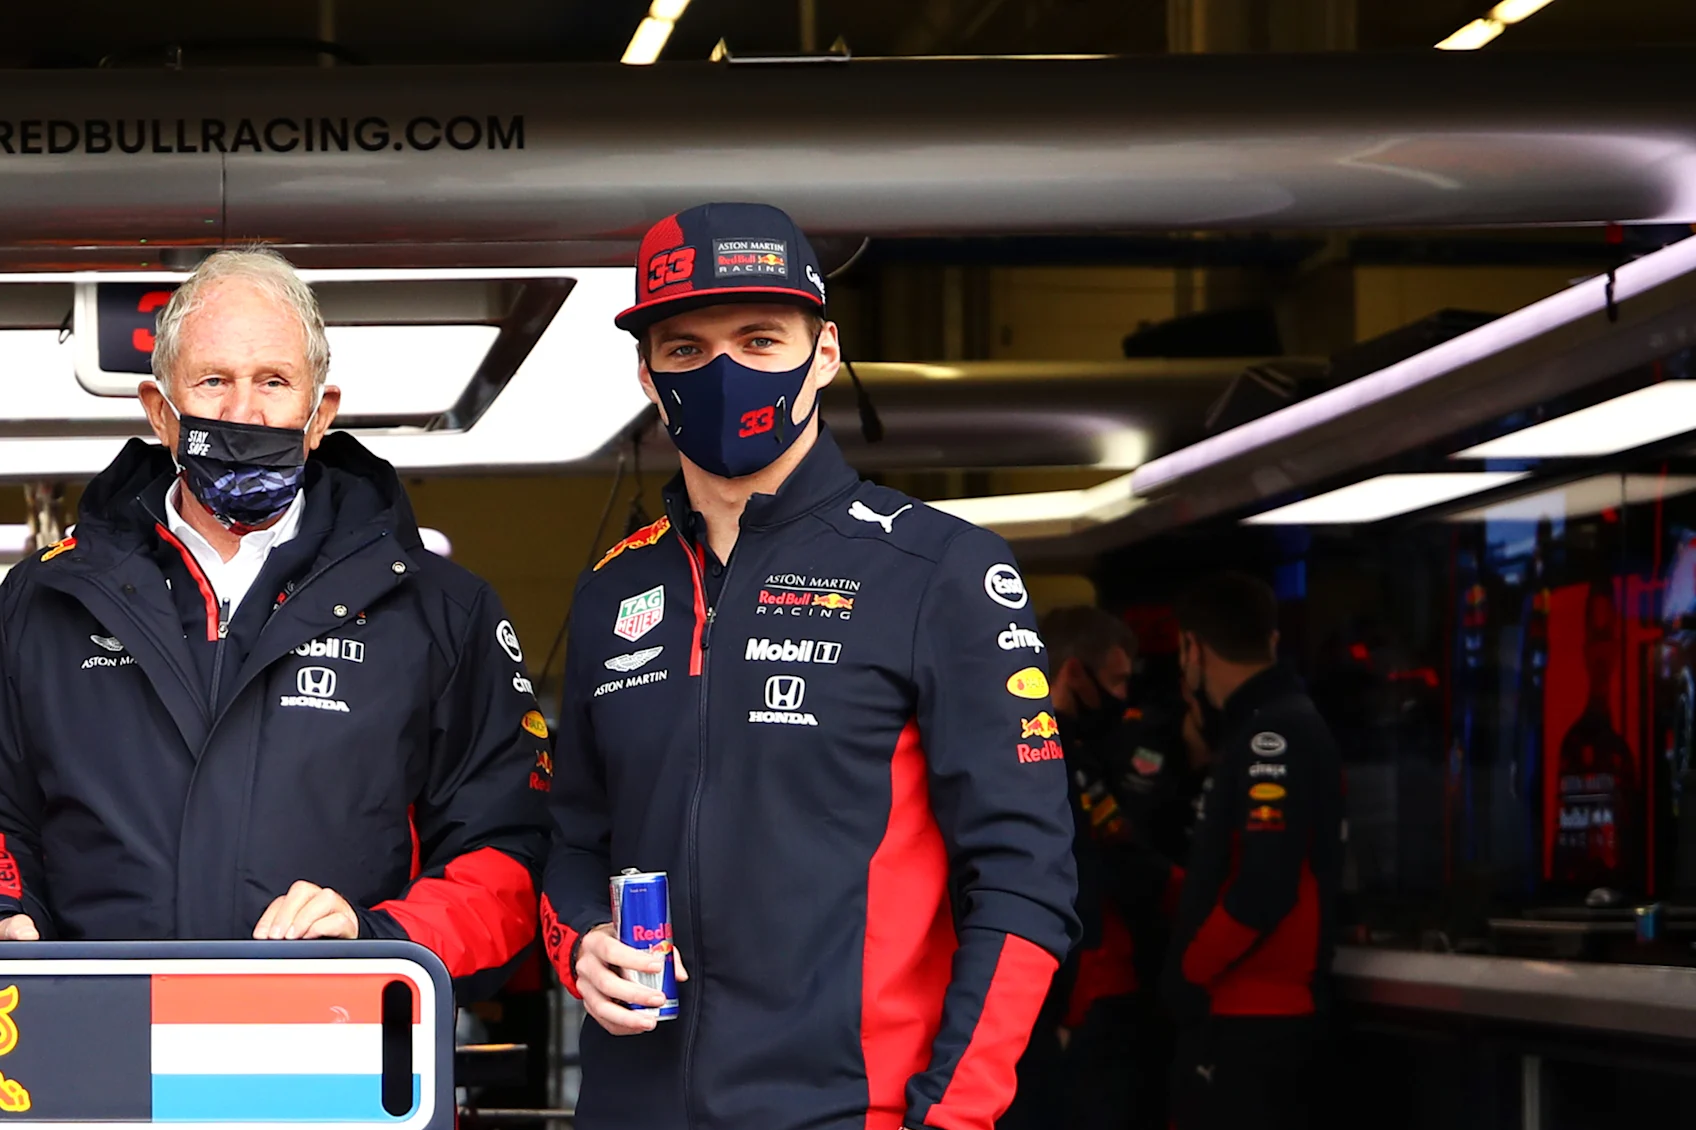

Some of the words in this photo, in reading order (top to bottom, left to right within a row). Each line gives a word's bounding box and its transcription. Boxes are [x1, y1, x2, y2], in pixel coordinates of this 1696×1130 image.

[718, 241, 748, 251] ASTON
[750, 241, 785, 252] MARTIN
[648, 246, 696, 293] 33
[718, 265, 786, 275] RACING
[738, 405, 775, 438] 33
[187, 430, 209, 443] STAY
[187, 443, 211, 456] SAFE
[765, 573, 807, 587] ASTON
[809, 577, 861, 591] MARTIN
[621, 589, 662, 619] TAG
[756, 606, 851, 620] RACING
[617, 608, 661, 638] HEUER
[295, 638, 340, 659] obil
[745, 638, 815, 663] Mobil
[81, 656, 117, 669] ASTON
[594, 680, 624, 697] ASTON
[625, 669, 668, 688] MARTIN
[280, 696, 350, 712] HONDA
[748, 711, 819, 726] HONDA
